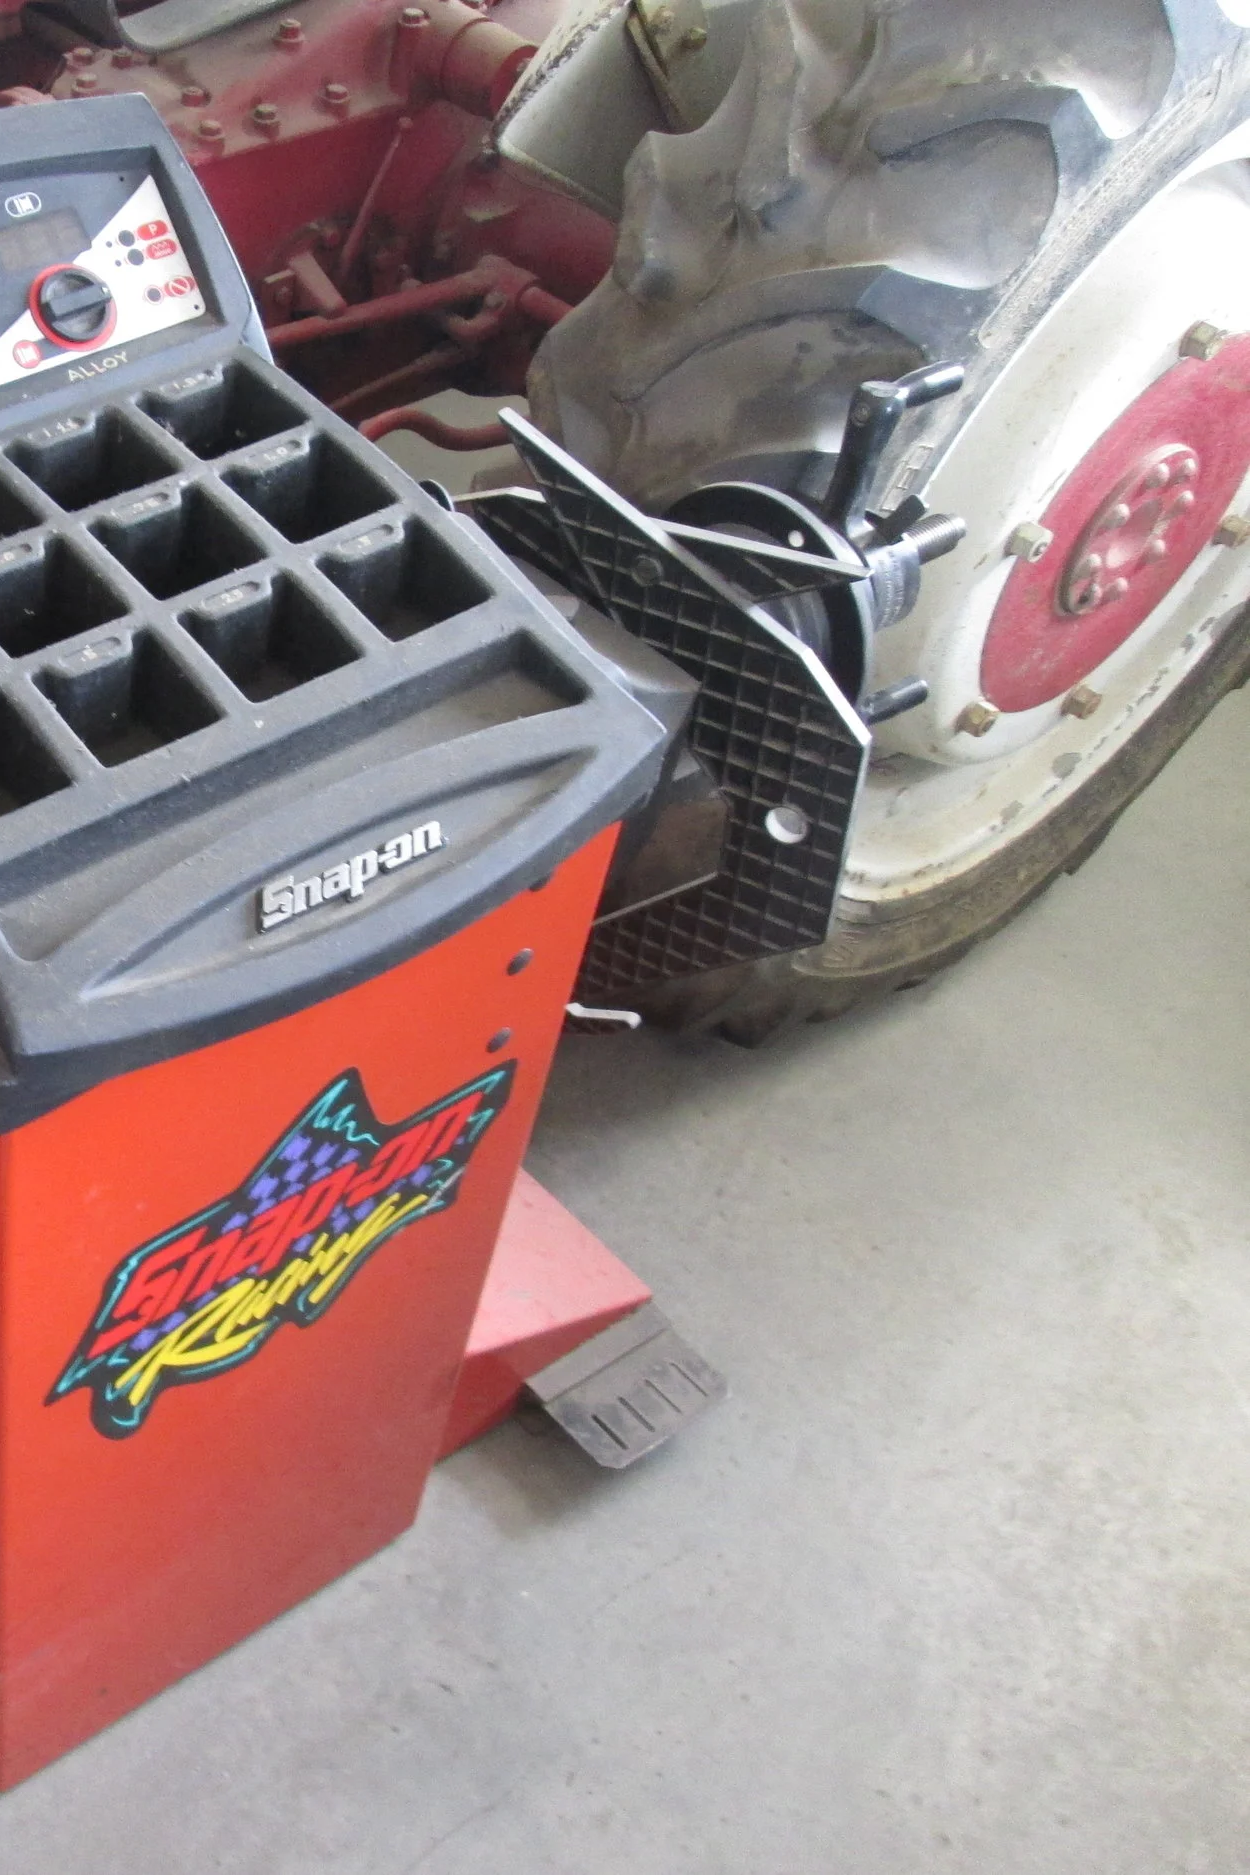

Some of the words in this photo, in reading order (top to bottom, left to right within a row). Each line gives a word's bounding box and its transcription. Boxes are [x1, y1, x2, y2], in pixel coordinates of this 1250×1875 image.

[67, 350, 129, 383] ALLOY
[261, 820, 443, 930] Snap-on
[86, 1091, 483, 1359] Snap-on
